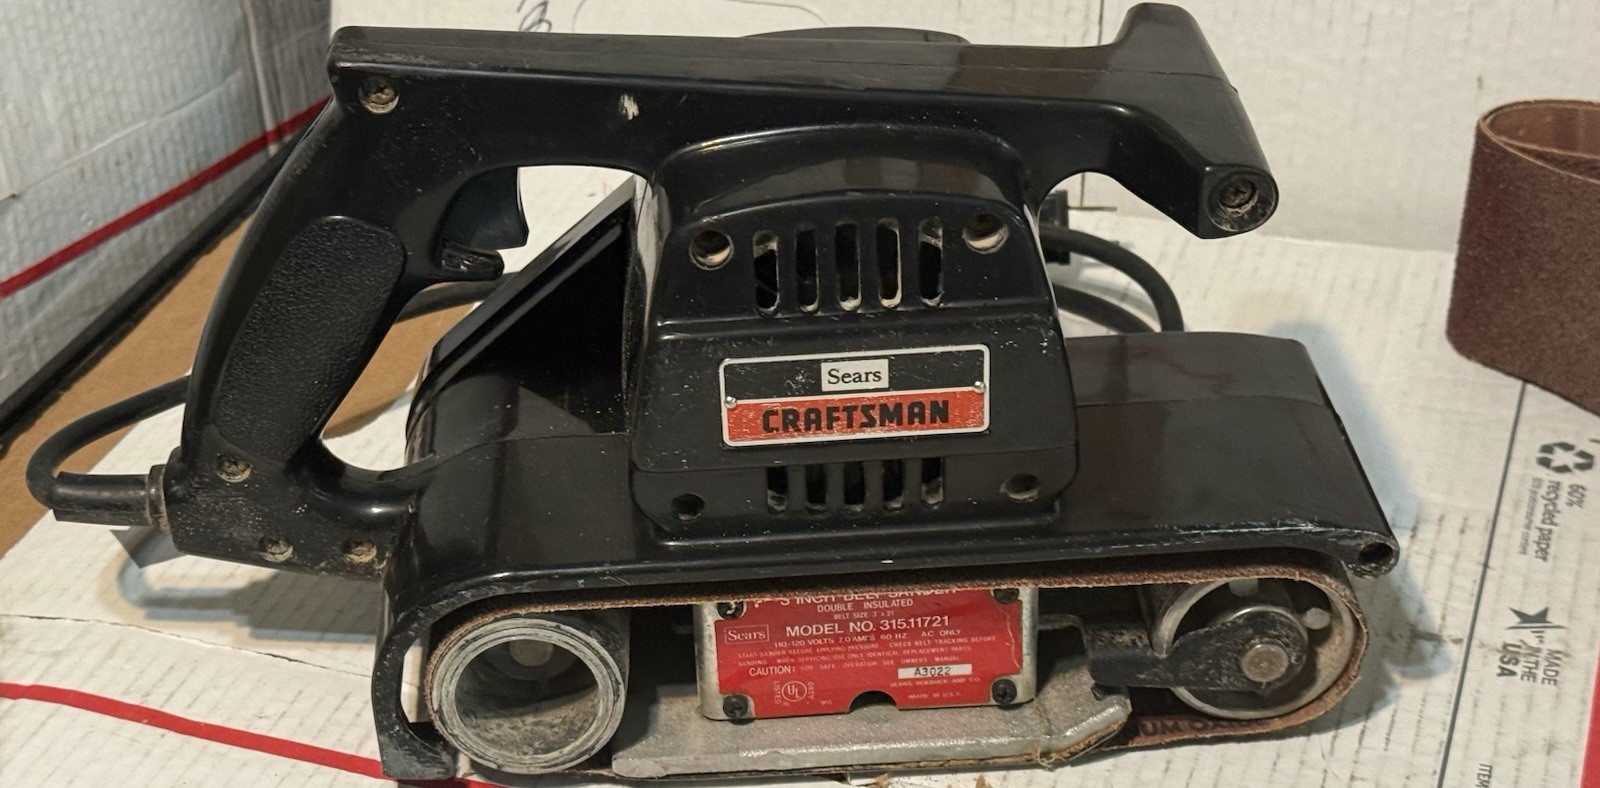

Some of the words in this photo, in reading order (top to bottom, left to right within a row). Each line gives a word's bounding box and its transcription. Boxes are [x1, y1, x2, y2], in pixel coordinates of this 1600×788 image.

[827, 367, 882, 384] Sears
[762, 400, 949, 433] CRAFTSMAN
[1541, 480, 1561, 527] recycled
[1533, 525, 1552, 562] paper
[817, 602, 853, 613] DOUBLE
[863, 599, 913, 610] INSULATED
[834, 613, 850, 621] BELT
[852, 611, 869, 619] SIZE
[786, 623, 844, 637] MODEL
[849, 620, 876, 632] NO.
[879, 615, 949, 631] 315.11721
[728, 630, 766, 641] Sears
[774, 640, 805, 648] 110-120
[807, 637, 834, 646] VOLTS
[935, 637, 968, 645] TRACKING
[903, 647, 948, 655] REPLACEMENT
[1496, 640, 1521, 677] USA
[749, 665, 796, 676] CAUTION:
[914, 666, 951, 677] A3022
[1520, 659, 1540, 683] THE
[1541, 648, 1562, 686] MADE
